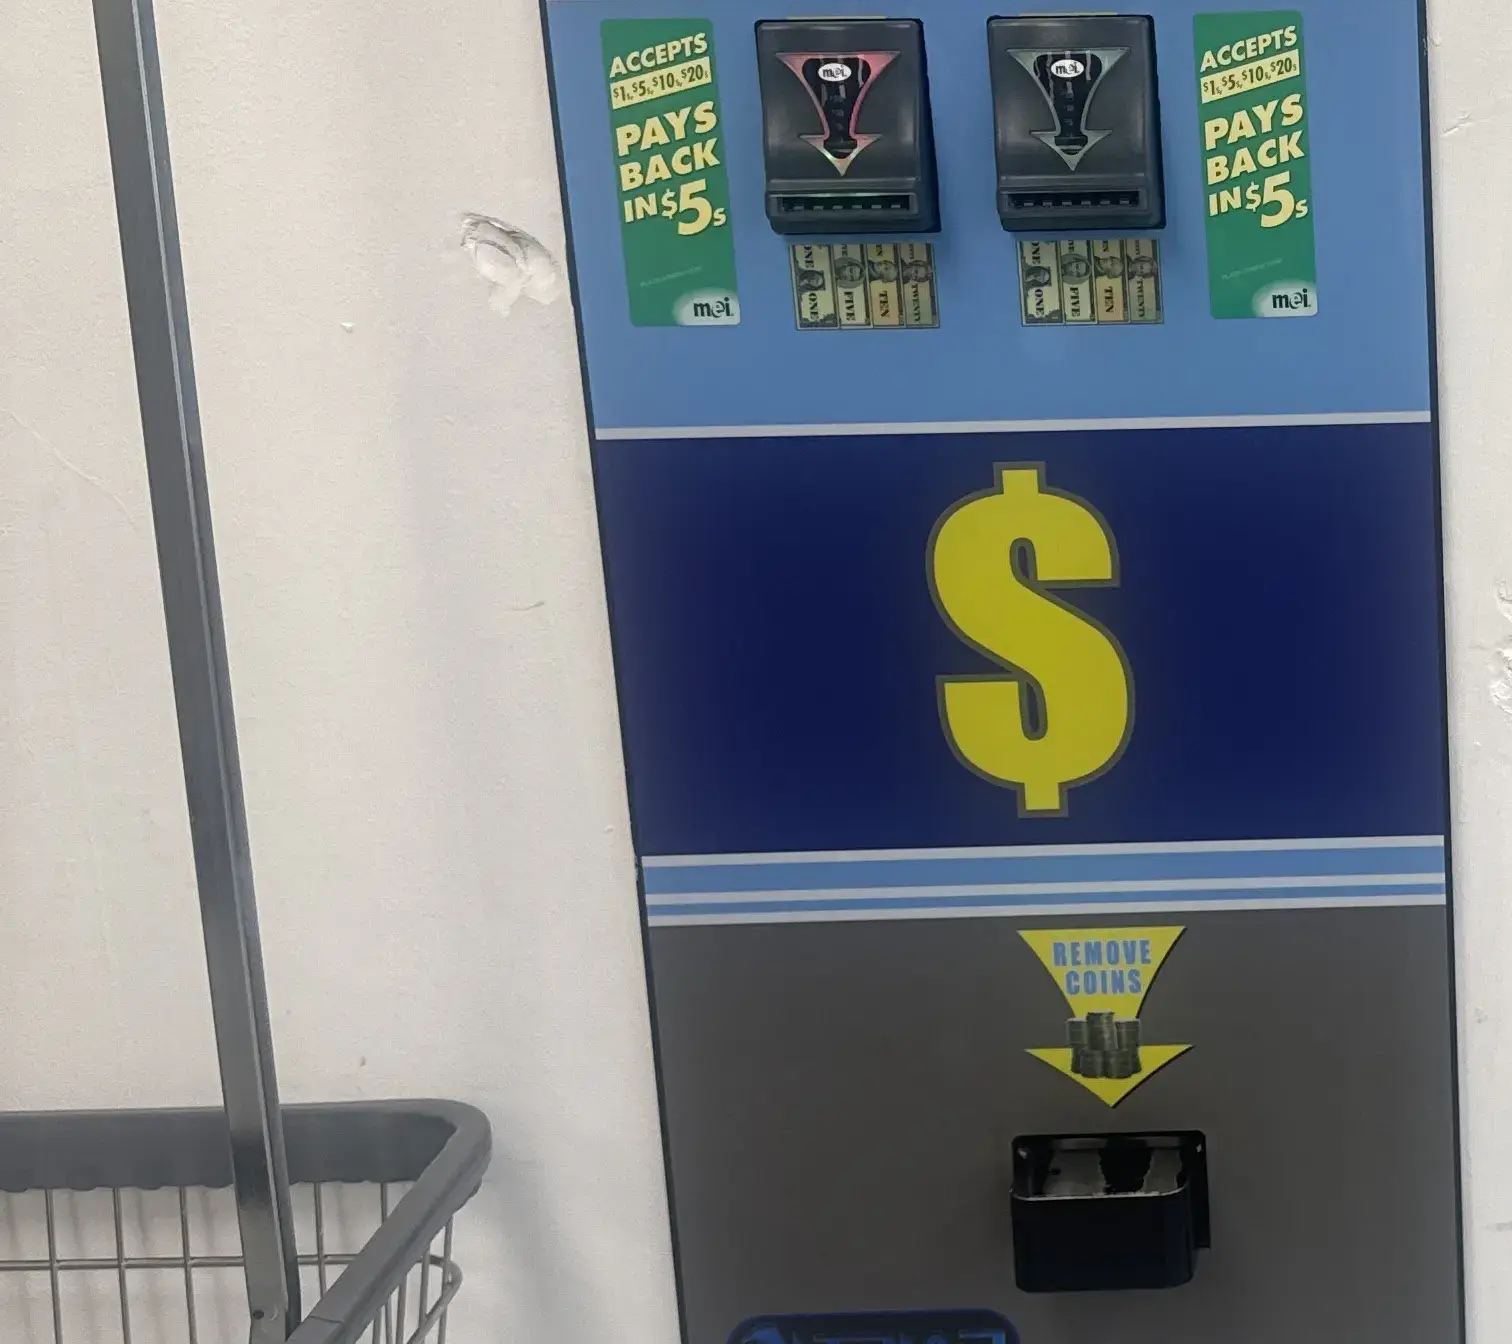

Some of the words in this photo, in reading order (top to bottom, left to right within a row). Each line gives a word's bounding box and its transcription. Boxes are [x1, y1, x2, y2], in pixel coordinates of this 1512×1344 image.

[609, 32, 708, 78] ACCEPTS
[1200, 25, 1298, 72] ACCEPTS
[822, 64, 847, 78] mei
[616, 100, 717, 156] PAYS
[1204, 93, 1303, 150] PAYS
[619, 137, 720, 192] BACK
[1206, 129, 1305, 185] BACK
[693, 296, 731, 318] mei
[808, 292, 819, 321] ONE
[844, 291, 856, 321] FIVE
[879, 290, 890, 318] TEN
[1034, 288, 1045, 316] ONE
[1070, 287, 1080, 317] FIVE
[1104, 286, 1114, 313] TEN
[1272, 288, 1309, 309] mei
[929, 464, 1132, 814] $
[1053, 940, 1152, 966] REMOVE
[1065, 969, 1142, 995] COINS
